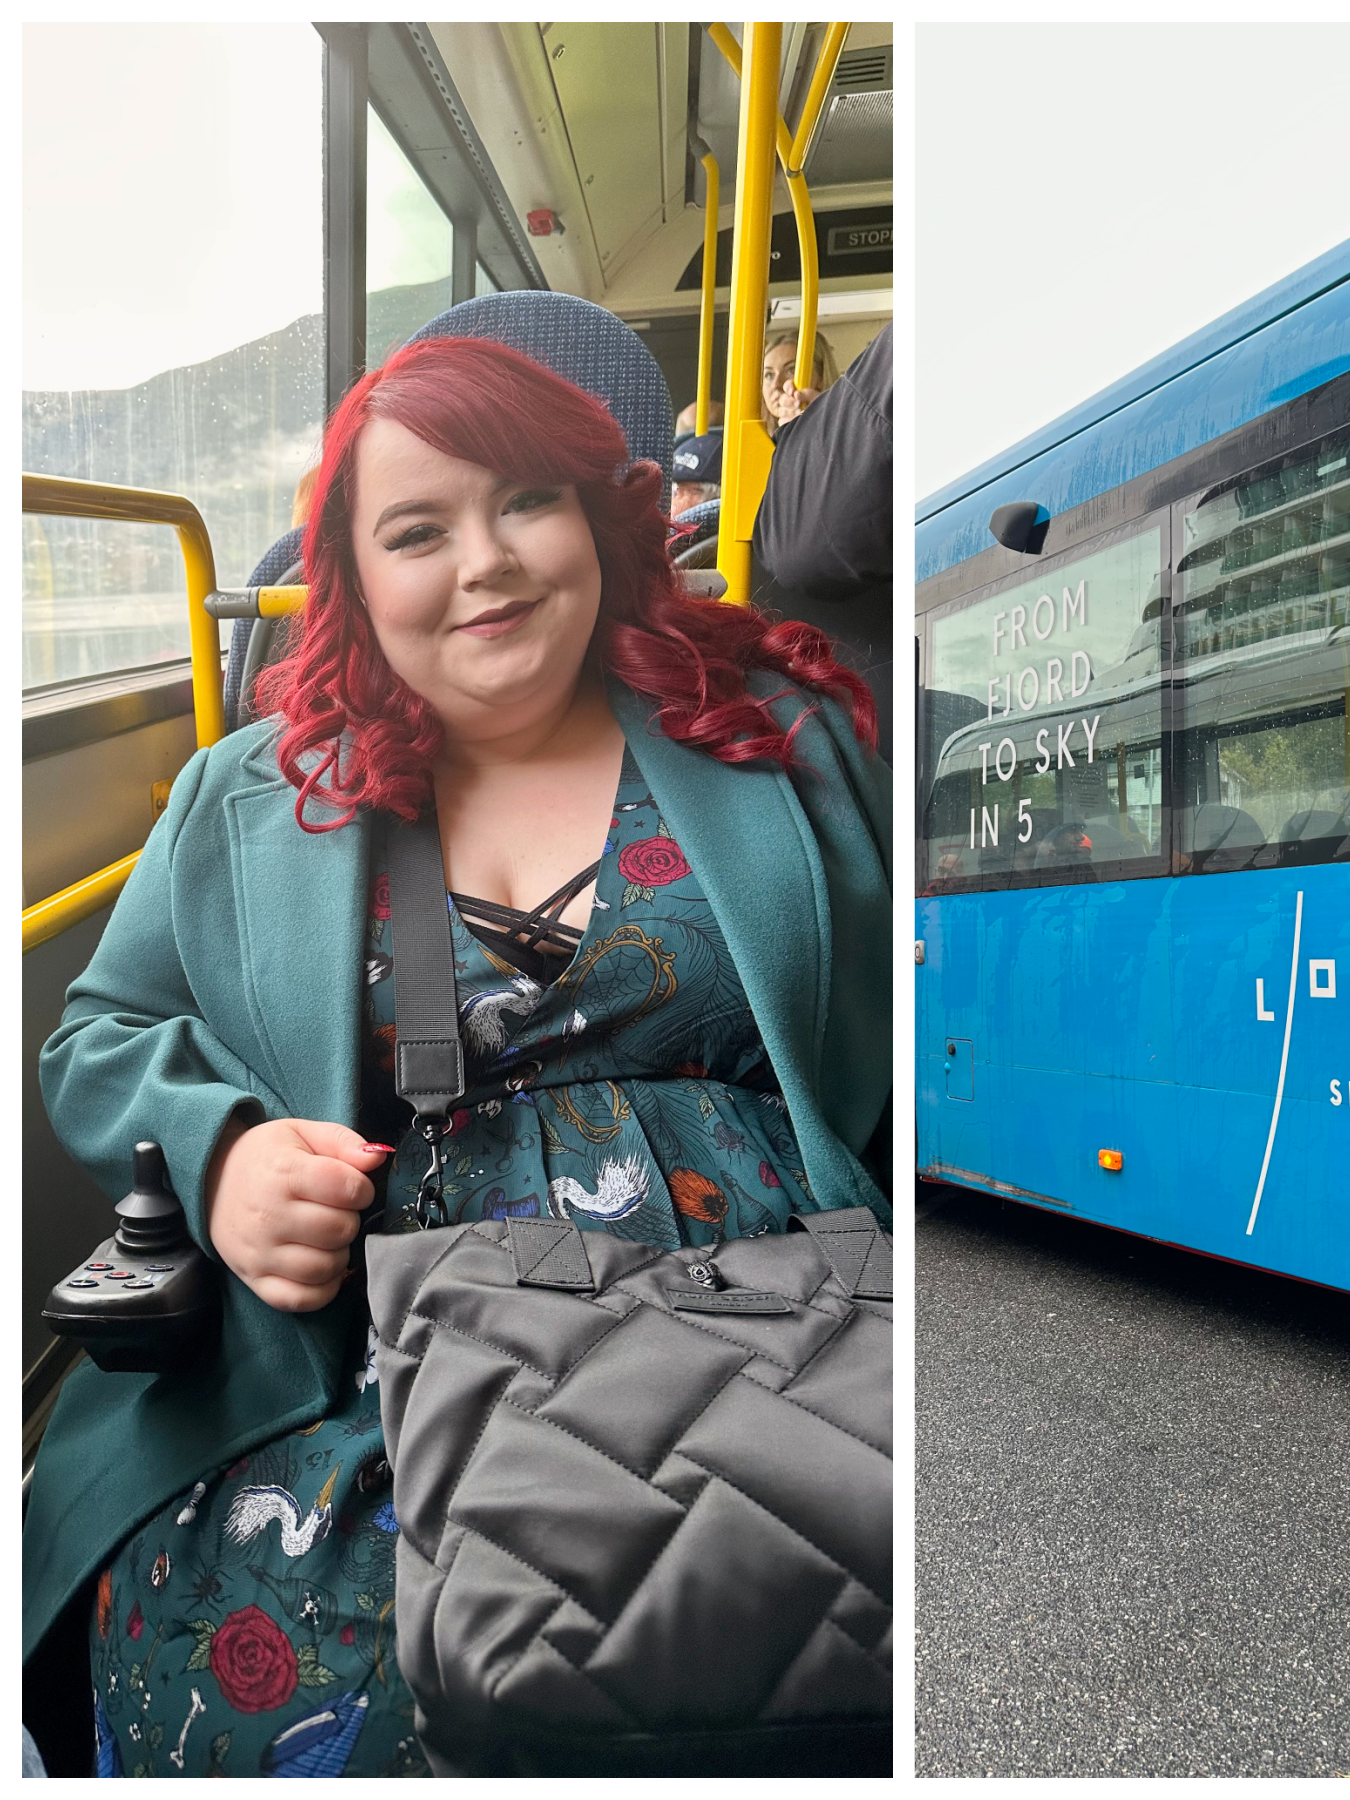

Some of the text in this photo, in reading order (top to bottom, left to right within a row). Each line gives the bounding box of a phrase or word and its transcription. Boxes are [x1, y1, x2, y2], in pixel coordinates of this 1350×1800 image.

[994, 580, 1086, 656] FROM
[987, 650, 1092, 721] FJORD
[979, 715, 1101, 785] TO SKY
[970, 798, 1033, 849] IN 5
